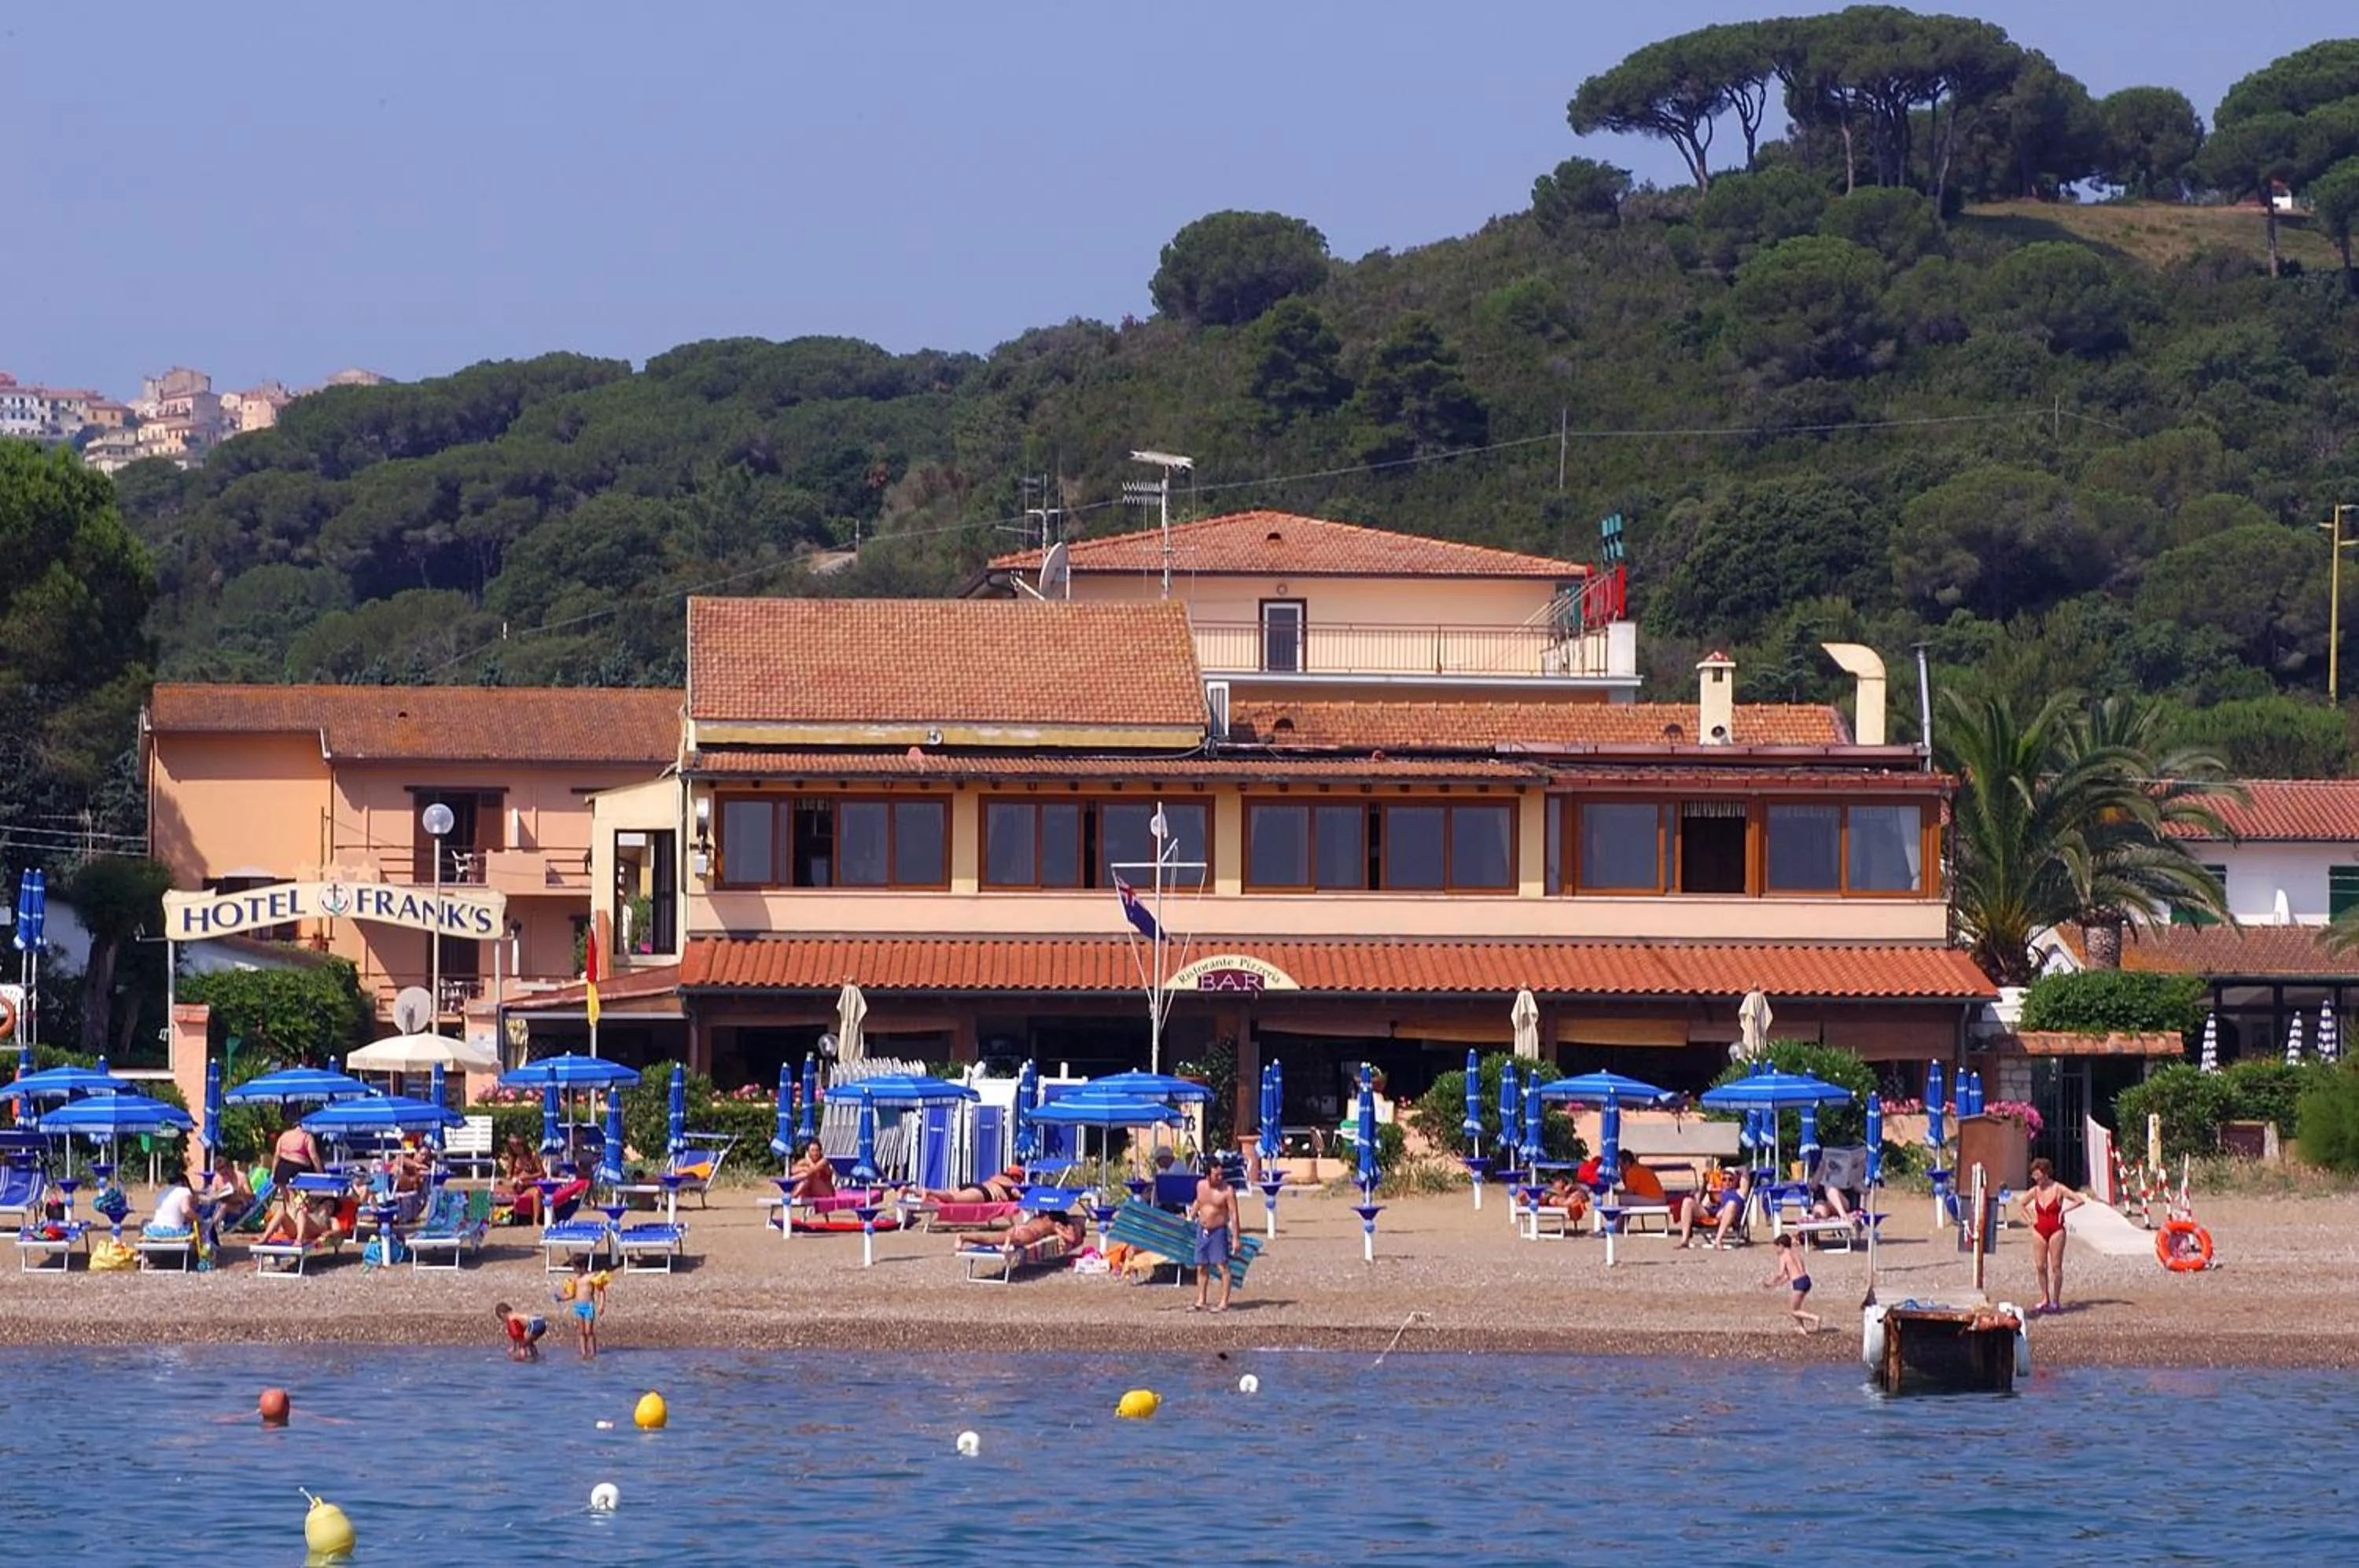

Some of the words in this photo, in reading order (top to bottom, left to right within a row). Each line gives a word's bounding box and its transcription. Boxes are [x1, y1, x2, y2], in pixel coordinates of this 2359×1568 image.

[182, 889, 306, 933] HOTEL
[356, 888, 492, 933] FRANK'S
[1179, 958, 1234, 984] Ristorante
[1240, 958, 1281, 984] Pizzeria
[1200, 974, 1264, 991] BAR
